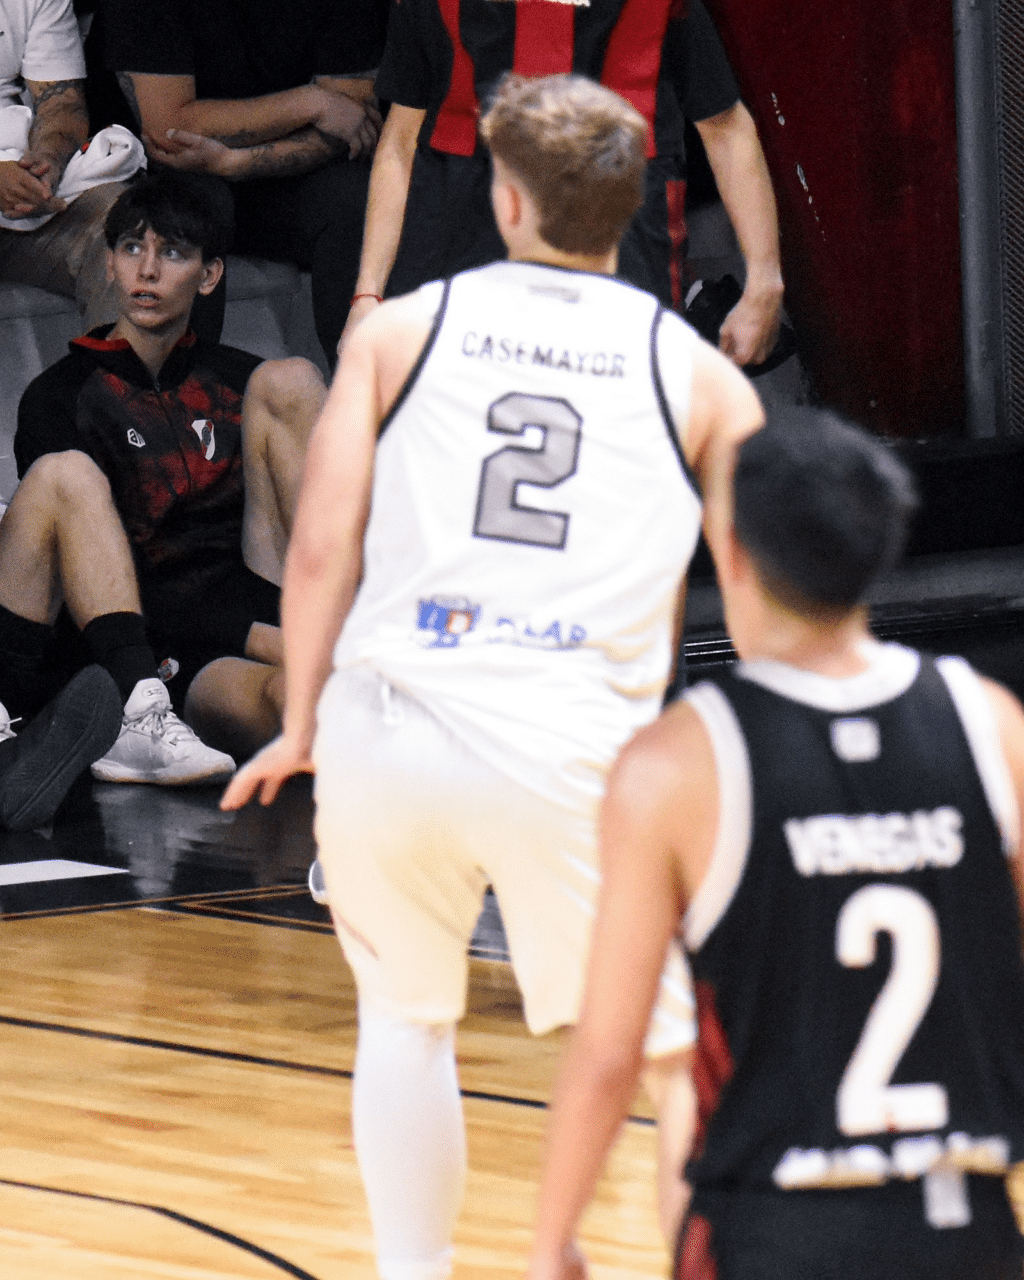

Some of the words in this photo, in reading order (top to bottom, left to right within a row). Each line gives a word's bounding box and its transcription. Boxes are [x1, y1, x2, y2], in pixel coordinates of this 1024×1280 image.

[461, 330, 626, 379] CASEMAYOR
[472, 390, 584, 552] 2
[783, 805, 966, 878] VENEGAS
[835, 883, 950, 1138] 2
